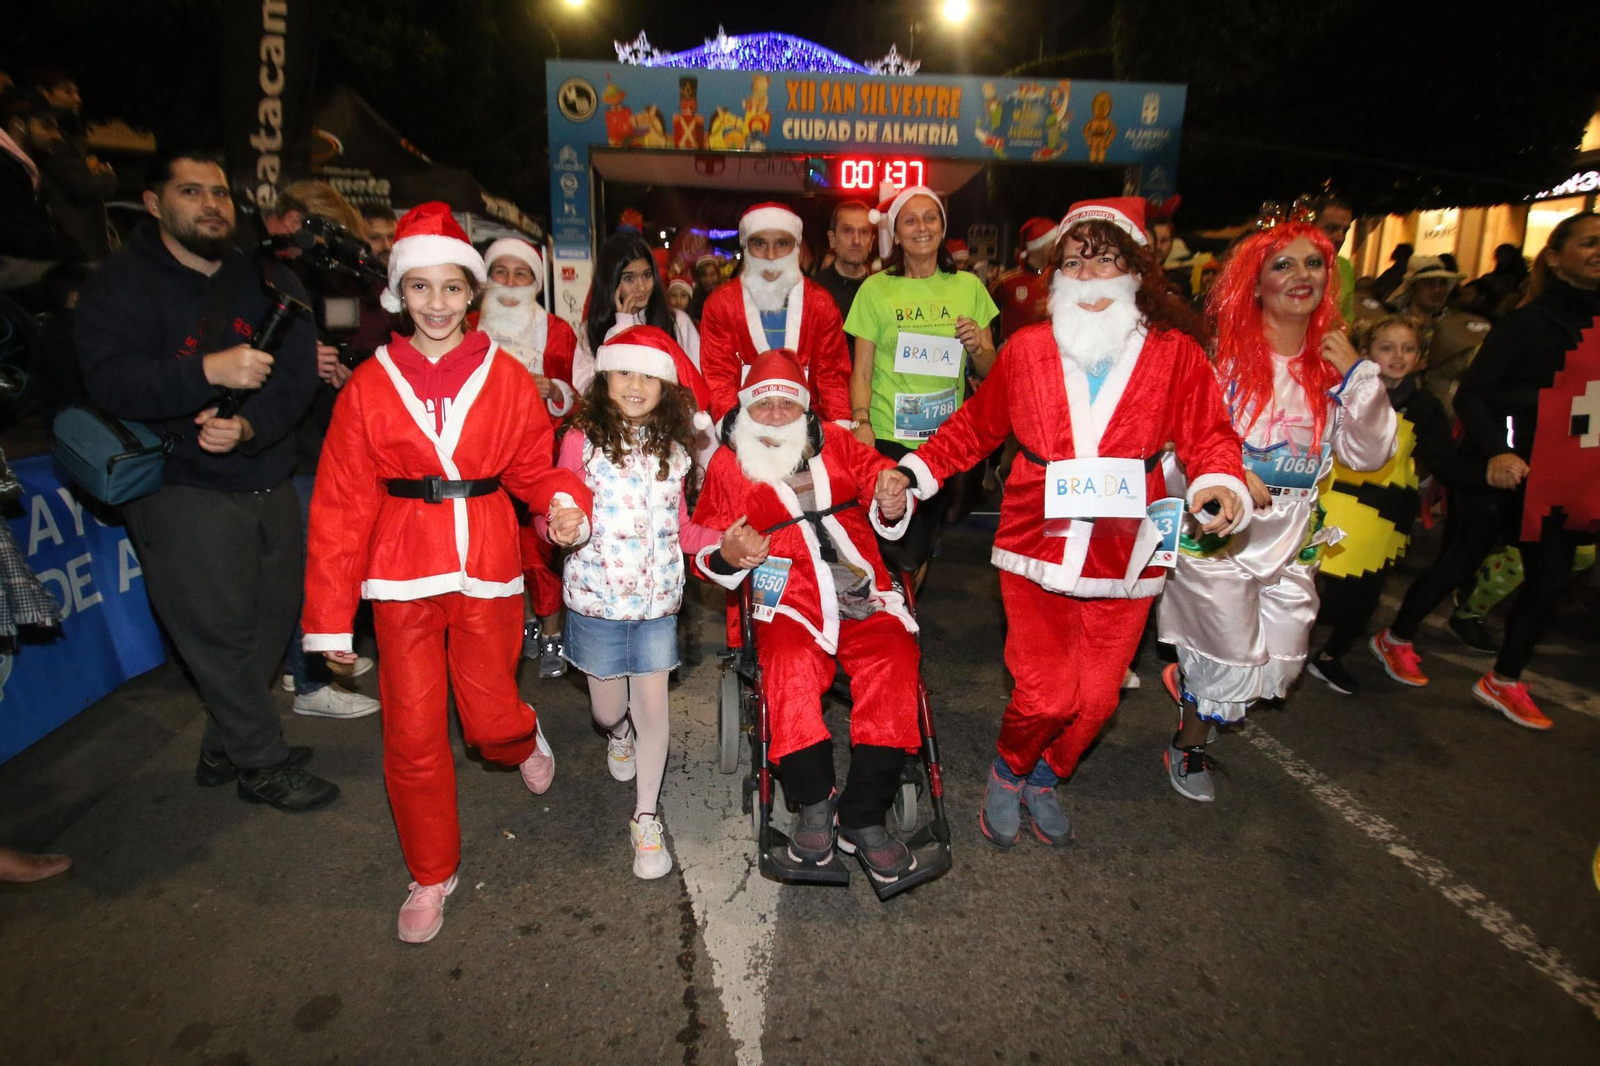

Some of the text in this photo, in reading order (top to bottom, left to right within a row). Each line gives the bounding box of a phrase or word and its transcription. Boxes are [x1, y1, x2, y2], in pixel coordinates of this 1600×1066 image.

[786, 80, 962, 119] XII SAN SILVESTRE
[782, 118, 958, 146] CIUDAD DE ALMERÍA
[923, 401, 953, 419] 1788
[1273, 456, 1318, 475] 1068
[753, 572, 784, 593] 1550
